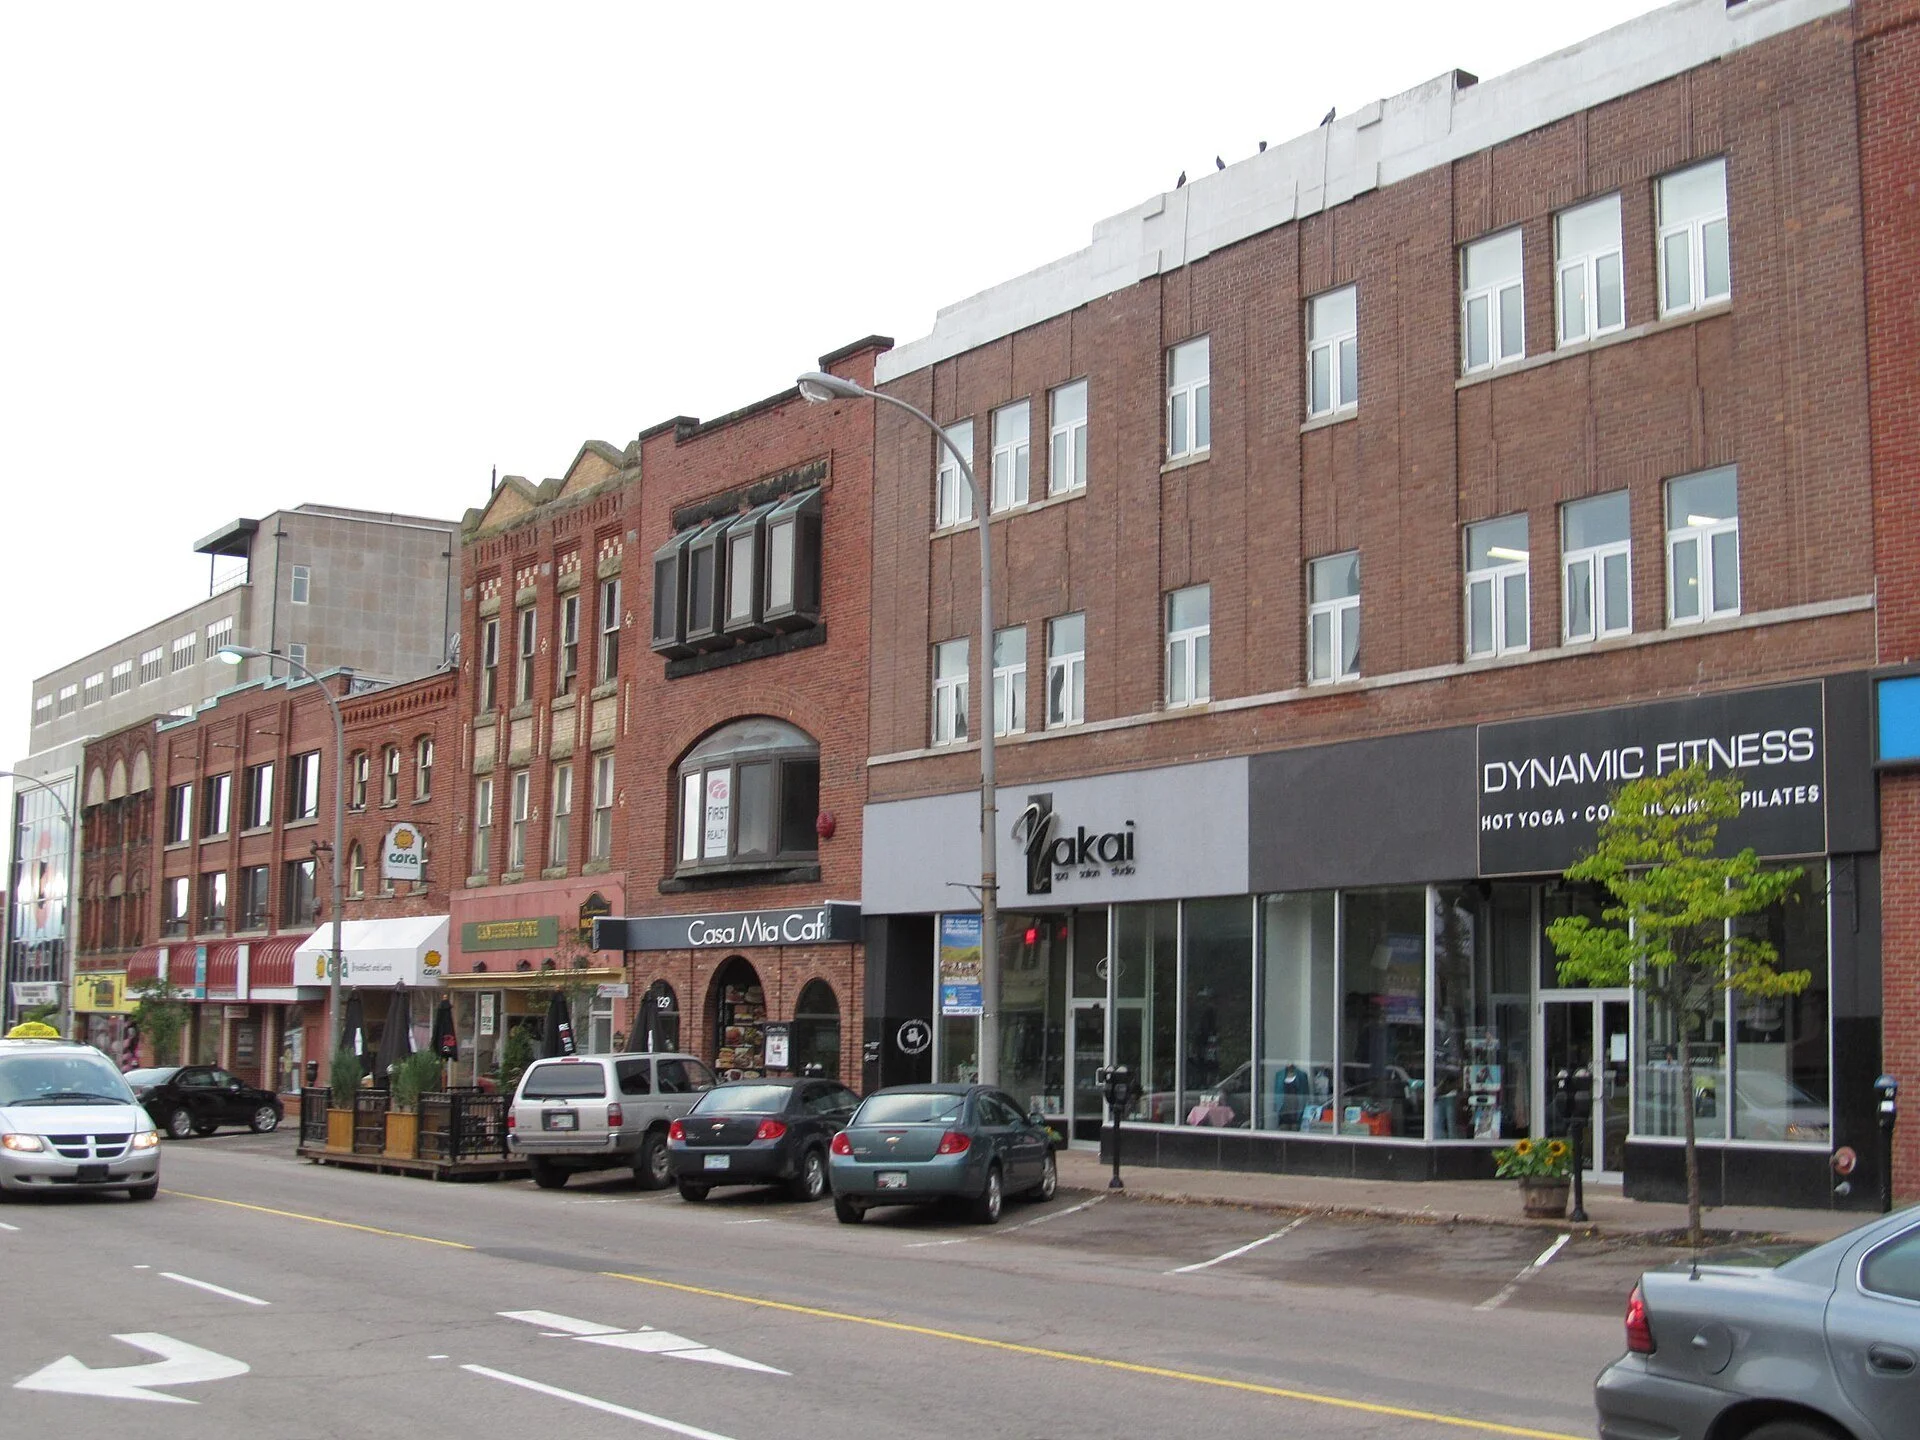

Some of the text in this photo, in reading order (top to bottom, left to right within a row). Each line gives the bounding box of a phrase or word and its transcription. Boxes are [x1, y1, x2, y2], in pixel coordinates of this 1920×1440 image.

[1484, 727, 1815, 793] DYNAMIC FITNESS
[707, 806, 729, 821] FIRST
[1481, 812, 1513, 831] HOT
[1519, 806, 1565, 827] YOGA
[1740, 784, 1820, 809] PILATES
[389, 853, 418, 865] cora
[687, 920, 735, 945] Casa
[738, 915, 779, 942] Mia
[783, 911, 825, 941] Caf
